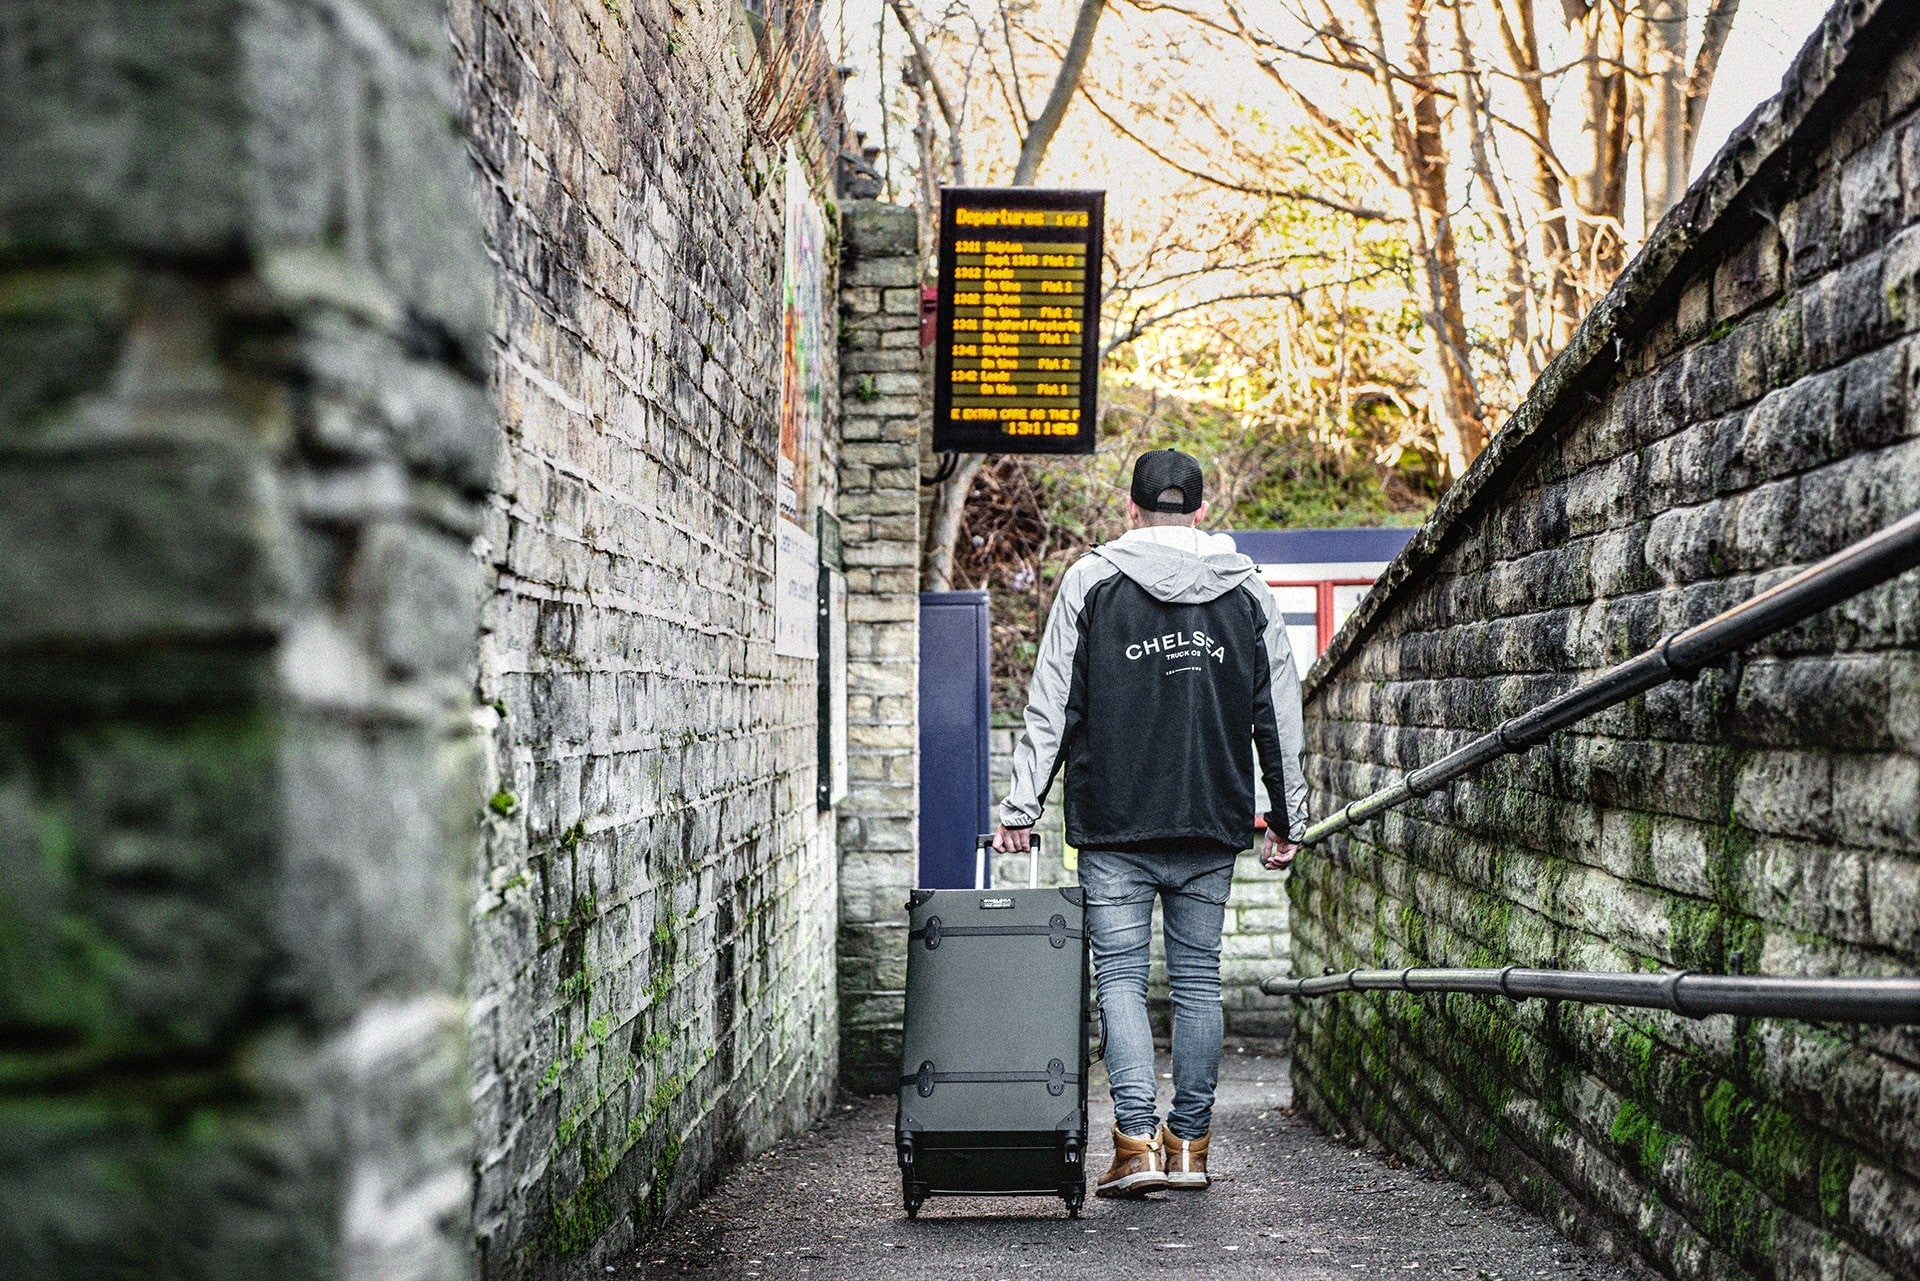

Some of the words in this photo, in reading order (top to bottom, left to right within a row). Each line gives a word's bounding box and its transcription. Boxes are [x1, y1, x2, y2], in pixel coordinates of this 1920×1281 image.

[956, 208, 1044, 226] Departures
[1056, 214, 1063, 226] 1
[1064, 214, 1078, 226] of
[1079, 214, 1088, 227] 2
[985, 241, 1023, 254] Skipton
[1042, 255, 1064, 267] Plat
[1066, 255, 1075, 267] 2
[985, 267, 1014, 279] Leeds
[984, 280, 998, 292] On
[999, 280, 1021, 292] time
[1041, 281, 1063, 293] Plat
[1065, 281, 1072, 293] 1
[984, 293, 1021, 306] Skipton
[983, 306, 997, 318] On
[999, 306, 1020, 318] time
[1040, 307, 1062, 319] Plat
[1064, 307, 1072, 319] 2
[983, 319, 1029, 331] Bradford
[982, 332, 996, 344] On
[998, 332, 1019, 344] time
[1039, 333, 1060, 344] Plat
[1063, 333, 1070, 345] 1
[982, 345, 1019, 358] Skipton
[981, 358, 995, 370] On
[997, 358, 1018, 370] time
[1038, 358, 1060, 370] Plat
[1061, 358, 1070, 370] 2
[981, 370, 1010, 382] Leeds
[980, 383, 994, 395] On
[996, 383, 1017, 395] time
[1037, 384, 1059, 395] Plat
[1060, 384, 1067, 395] 1
[963, 408, 997, 420] EXTRA
[1000, 408, 1027, 420] CARE
[1030, 409, 1046, 420] AS
[1048, 409, 1070, 420] THE
[1125, 630, 1225, 663] CHELSEA
[1165, 650, 1190, 660] TRUCK
